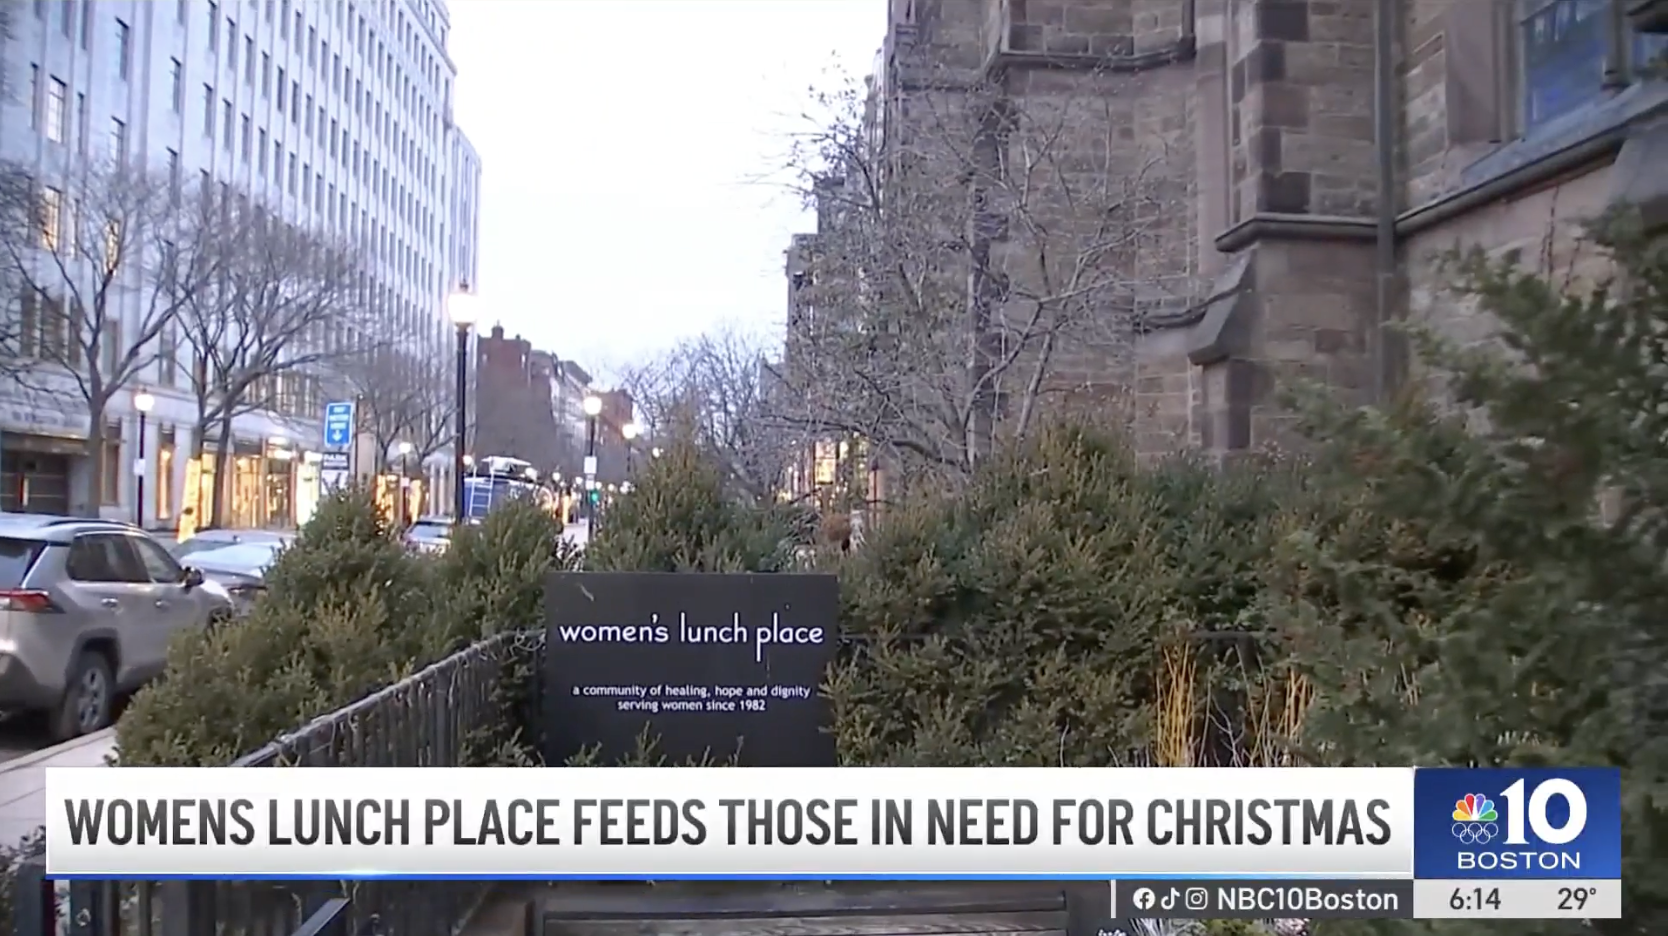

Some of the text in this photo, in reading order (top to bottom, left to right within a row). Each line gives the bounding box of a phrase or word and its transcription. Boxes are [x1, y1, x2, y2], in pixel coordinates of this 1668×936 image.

[559, 612, 824, 663] women's lunch place
[572, 684, 811, 699] a community of healing, hope and dignity
[617, 699, 767, 713] serving women since 1982
